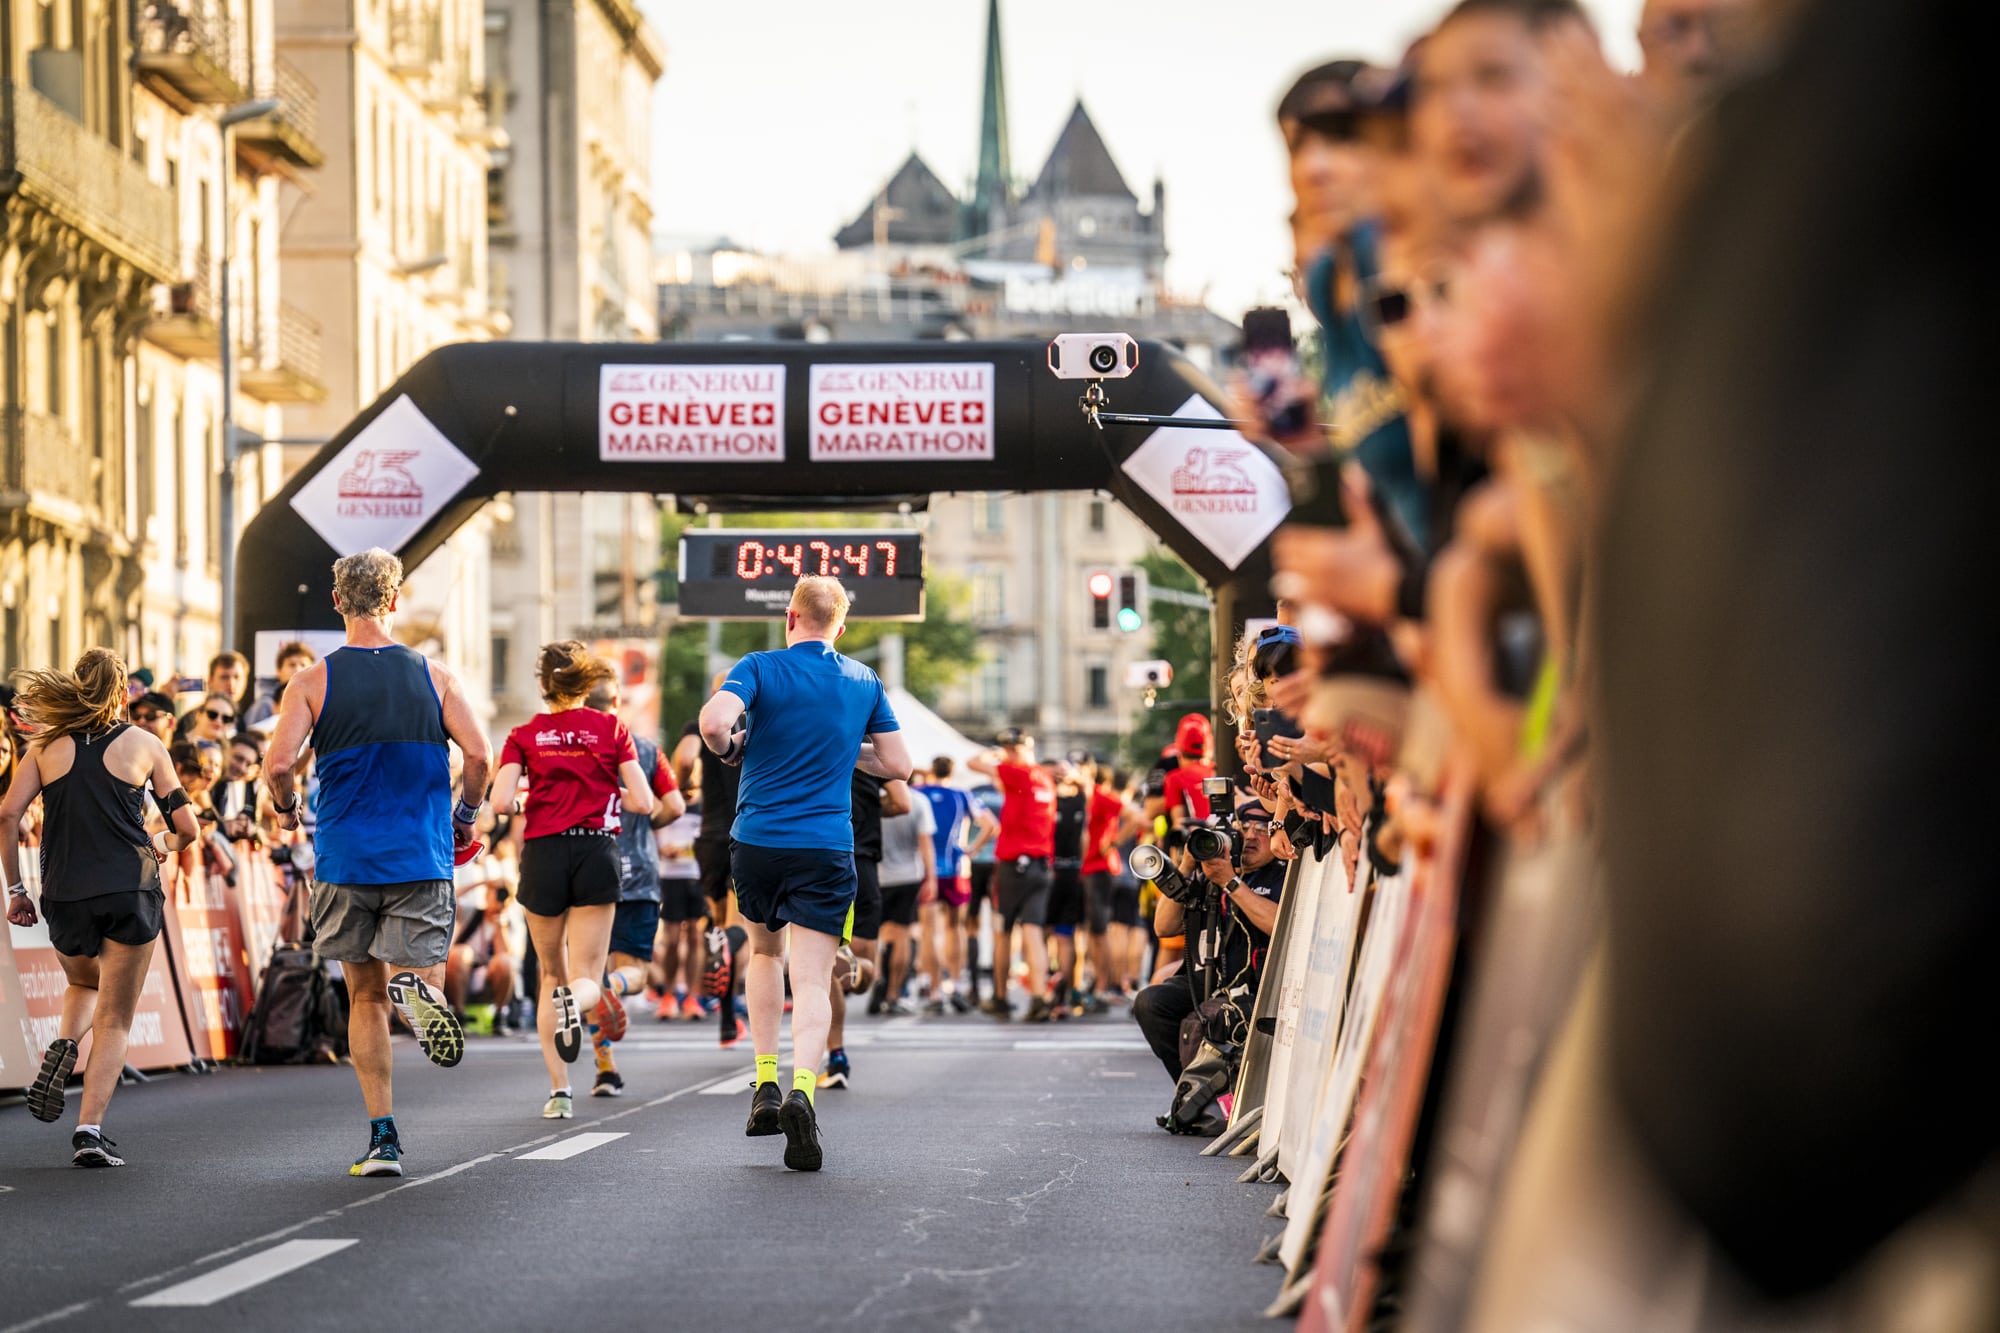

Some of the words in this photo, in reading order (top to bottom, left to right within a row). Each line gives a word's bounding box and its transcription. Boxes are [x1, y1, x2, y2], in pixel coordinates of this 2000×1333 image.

[648, 373, 775, 393] GENERALI
[858, 371, 984, 392] GENERALI
[609, 396, 746, 426] GENÈVE
[818, 394, 957, 425] GENÈVE
[608, 432, 777, 455] MARATHON
[818, 431, 986, 454] MARATHON
[336, 501, 423, 517] GENERALI
[1173, 497, 1258, 513] GENERALI
[736, 540, 898, 580] 0:47:47
